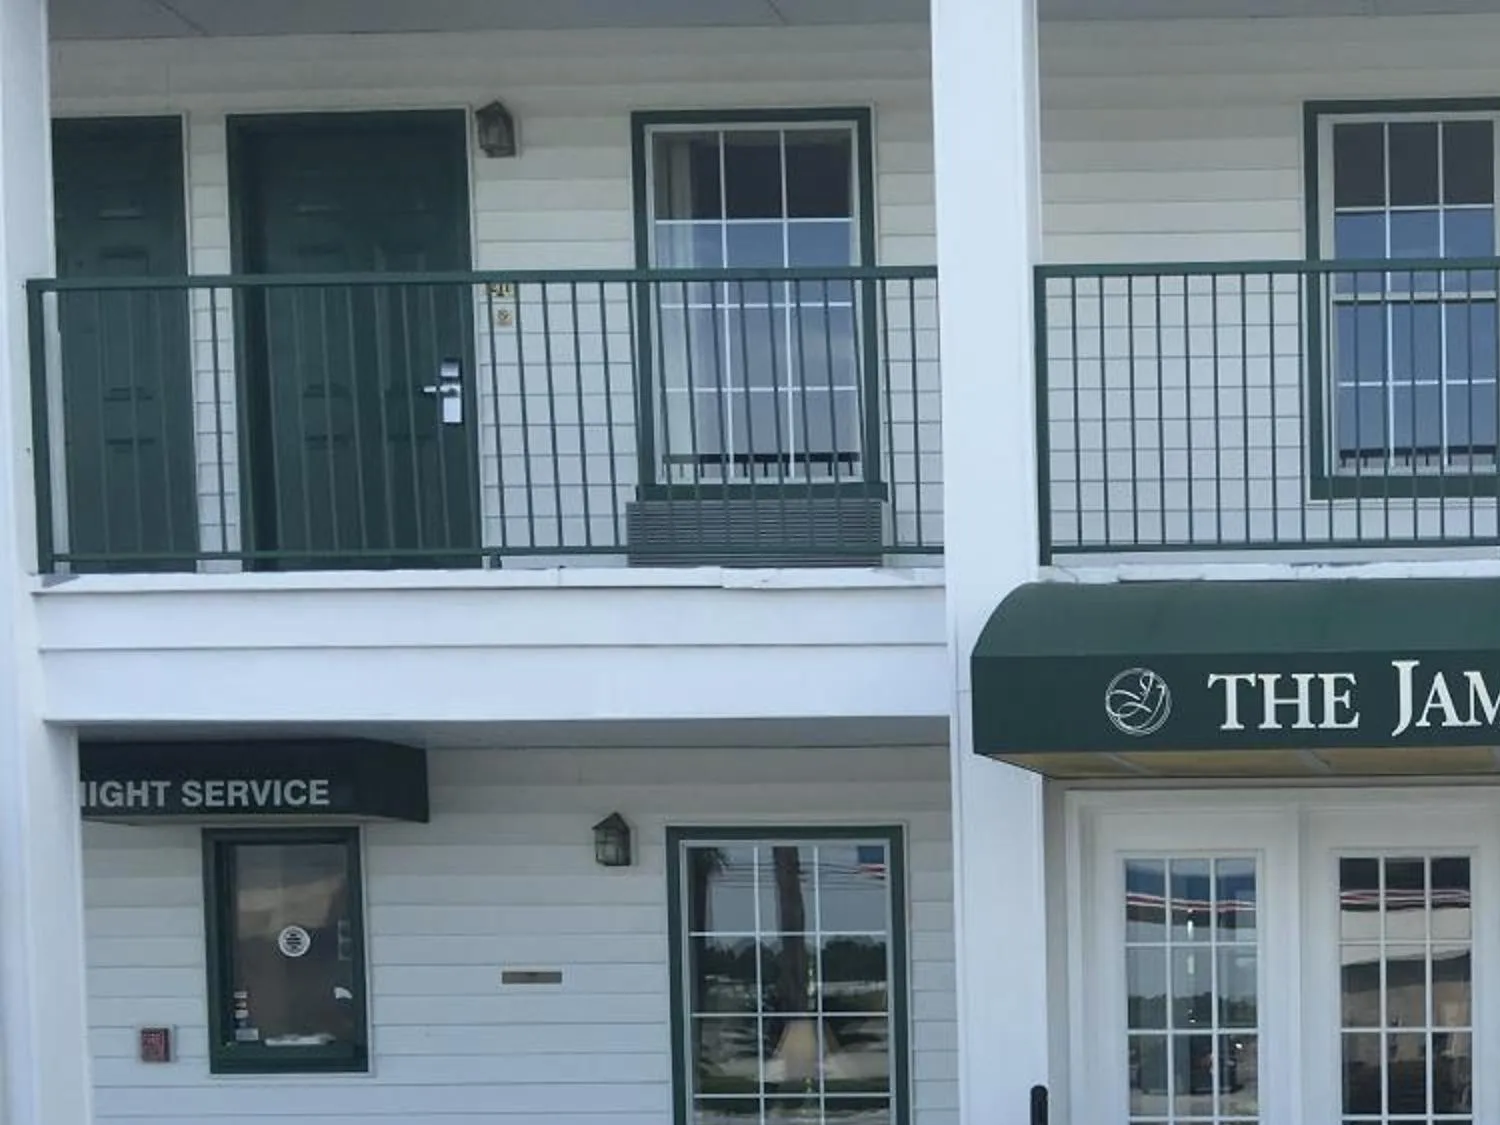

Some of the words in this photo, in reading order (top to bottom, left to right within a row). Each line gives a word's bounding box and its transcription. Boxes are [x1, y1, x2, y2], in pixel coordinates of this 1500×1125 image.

[1207, 672, 1360, 730] THE
[80, 780, 171, 808] IGHT
[181, 779, 330, 807] SERVICE
